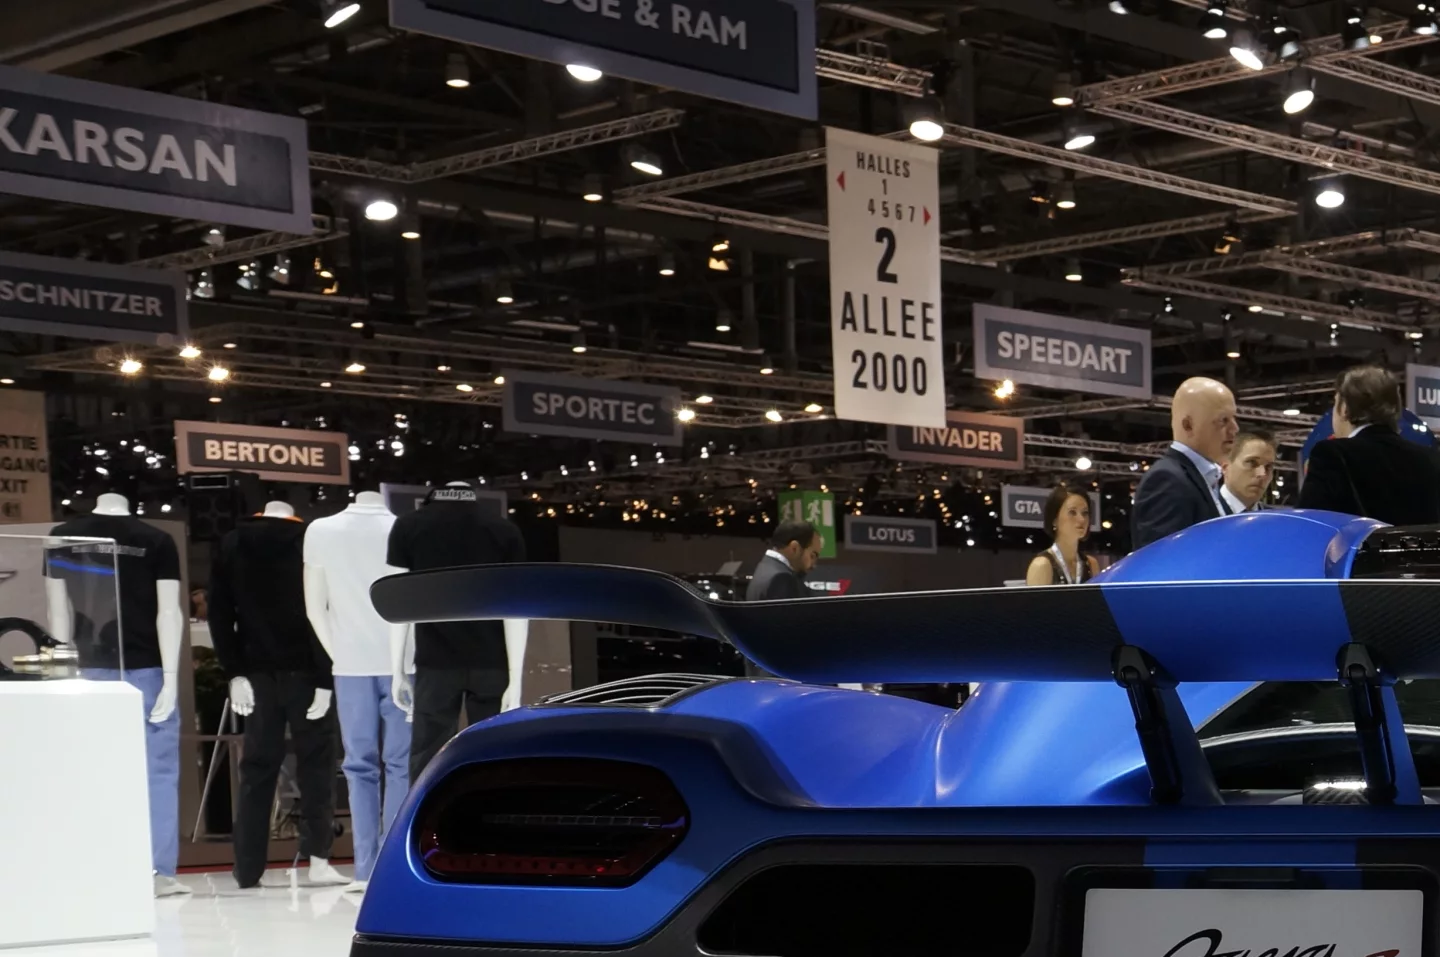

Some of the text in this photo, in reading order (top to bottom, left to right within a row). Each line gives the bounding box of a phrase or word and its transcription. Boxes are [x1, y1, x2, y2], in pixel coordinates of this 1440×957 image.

[672, 4, 747, 50] RAM
[0, 106, 237, 187] KARSAN
[856, 151, 911, 179] HALLES
[881, 178, 888, 196] 1
[875, 226, 898, 284] 2
[0, 280, 164, 318] SCHNITZER
[840, 291, 936, 343] ALLEE
[997, 330, 1132, 375] SPEEDART
[851, 349, 928, 397] 2000
[532, 391, 656, 426] SPORTEC
[204, 439, 326, 468] BERTONE
[912, 425, 1004, 453] INVADER
[1014, 500, 1042, 516] GTA
[868, 526, 916, 544] LOTUS
